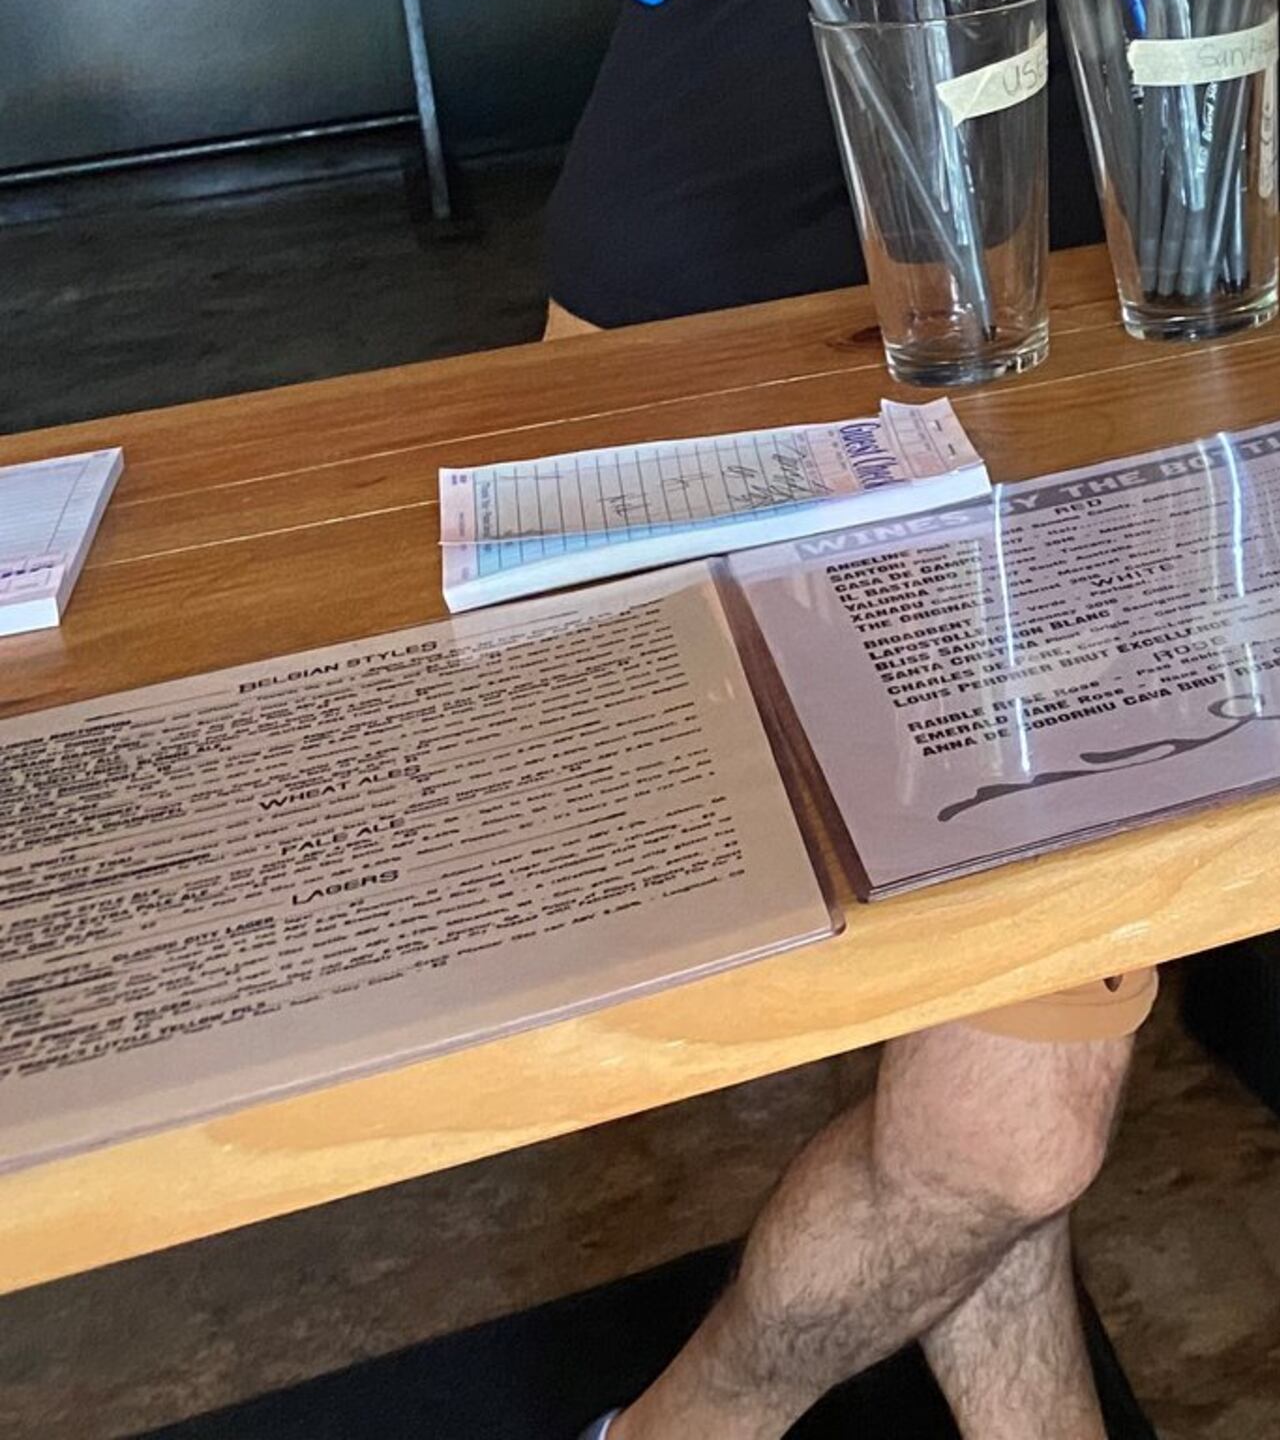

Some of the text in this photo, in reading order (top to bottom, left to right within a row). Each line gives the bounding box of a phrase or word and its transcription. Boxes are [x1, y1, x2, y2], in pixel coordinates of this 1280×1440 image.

[802, 510, 971, 556] WINES
[1060, 471, 1147, 499] THE
[1054, 498, 1103, 514] RED
[826, 550, 909, 573] ANGELINE
[831, 561, 905, 583] SARTORI
[1092, 563, 1174, 587] WHITE
[836, 576, 882, 593] CASA
[888, 569, 915, 580] DE
[839, 593, 857, 602] IL
[866, 571, 957, 597] BASTARDO
[846, 589, 928, 613] YALUMBA
[851, 600, 924, 622] XANADU
[856, 619, 892, 633] THE
[900, 596, 993, 623] ORIGINALS
[864, 619, 972, 650] BROADBENT
[875, 652, 930, 671] BLISS
[1051, 609, 1110, 629] BLANC
[239, 640, 438, 694] BELGIAN STYLES
[881, 662, 942, 682] SANTA
[888, 669, 974, 695] CHARLES
[895, 688, 950, 707] LOUIS
[1060, 649, 1111, 667] BRUT
[909, 707, 985, 732] RABBLE
[922, 736, 976, 756] ANNA
[984, 728, 1010, 740] DE
[1124, 687, 1172, 705] CAVA
[1178, 672, 1226, 691] BRUT
[915, 715, 1008, 744] EMERALD
[259, 764, 421, 810] WHEAT ALES
[281, 817, 405, 856] PALE ALE
[291, 870, 399, 905] LAGERS
